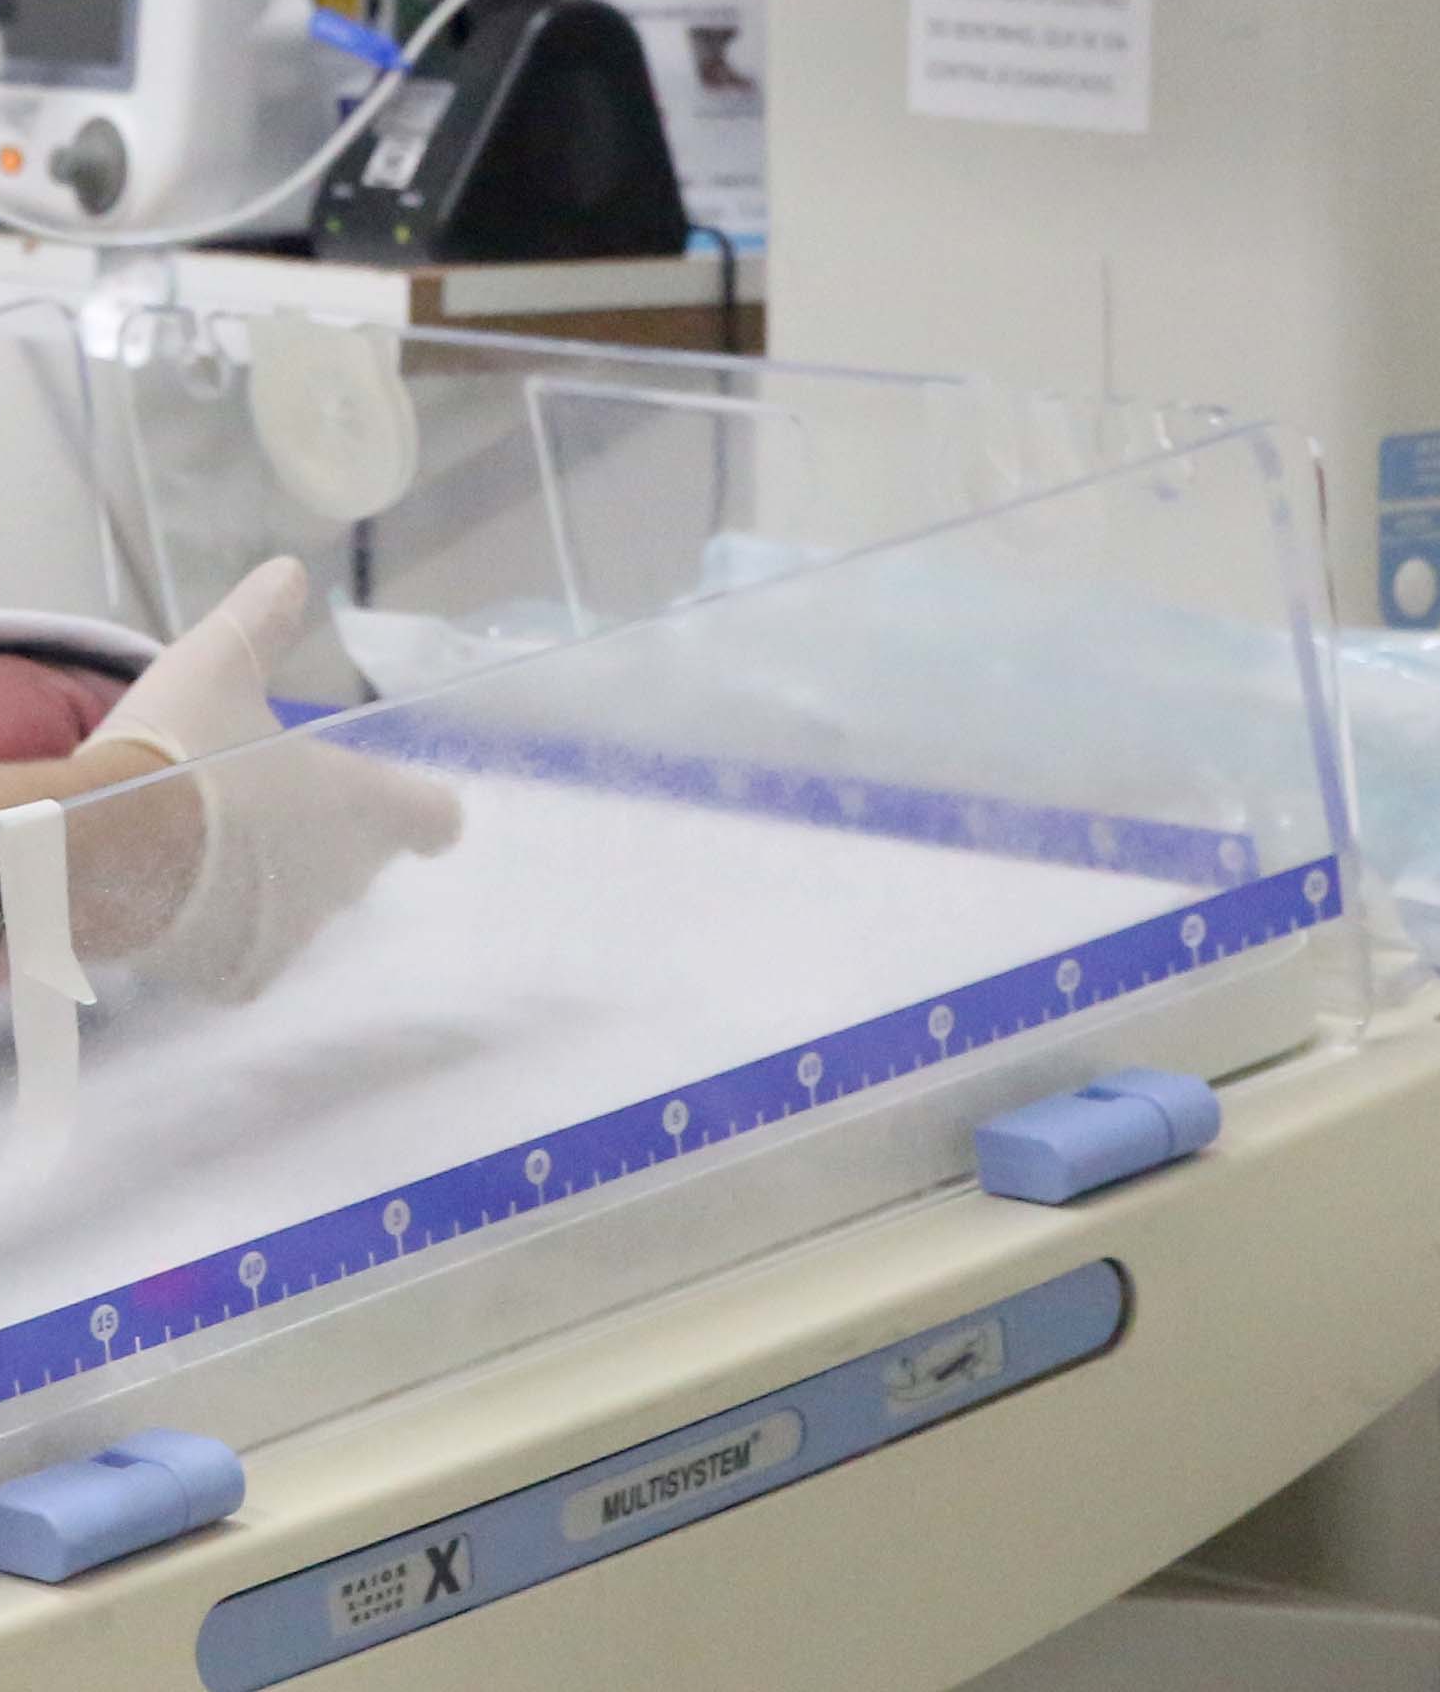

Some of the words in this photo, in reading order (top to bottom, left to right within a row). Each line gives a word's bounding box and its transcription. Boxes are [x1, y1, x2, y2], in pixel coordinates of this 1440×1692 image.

[96, 1312, 114, 1333] 15
[601, 1439, 751, 1525] MULTISYSTEM
[423, 1537, 461, 1605] X
